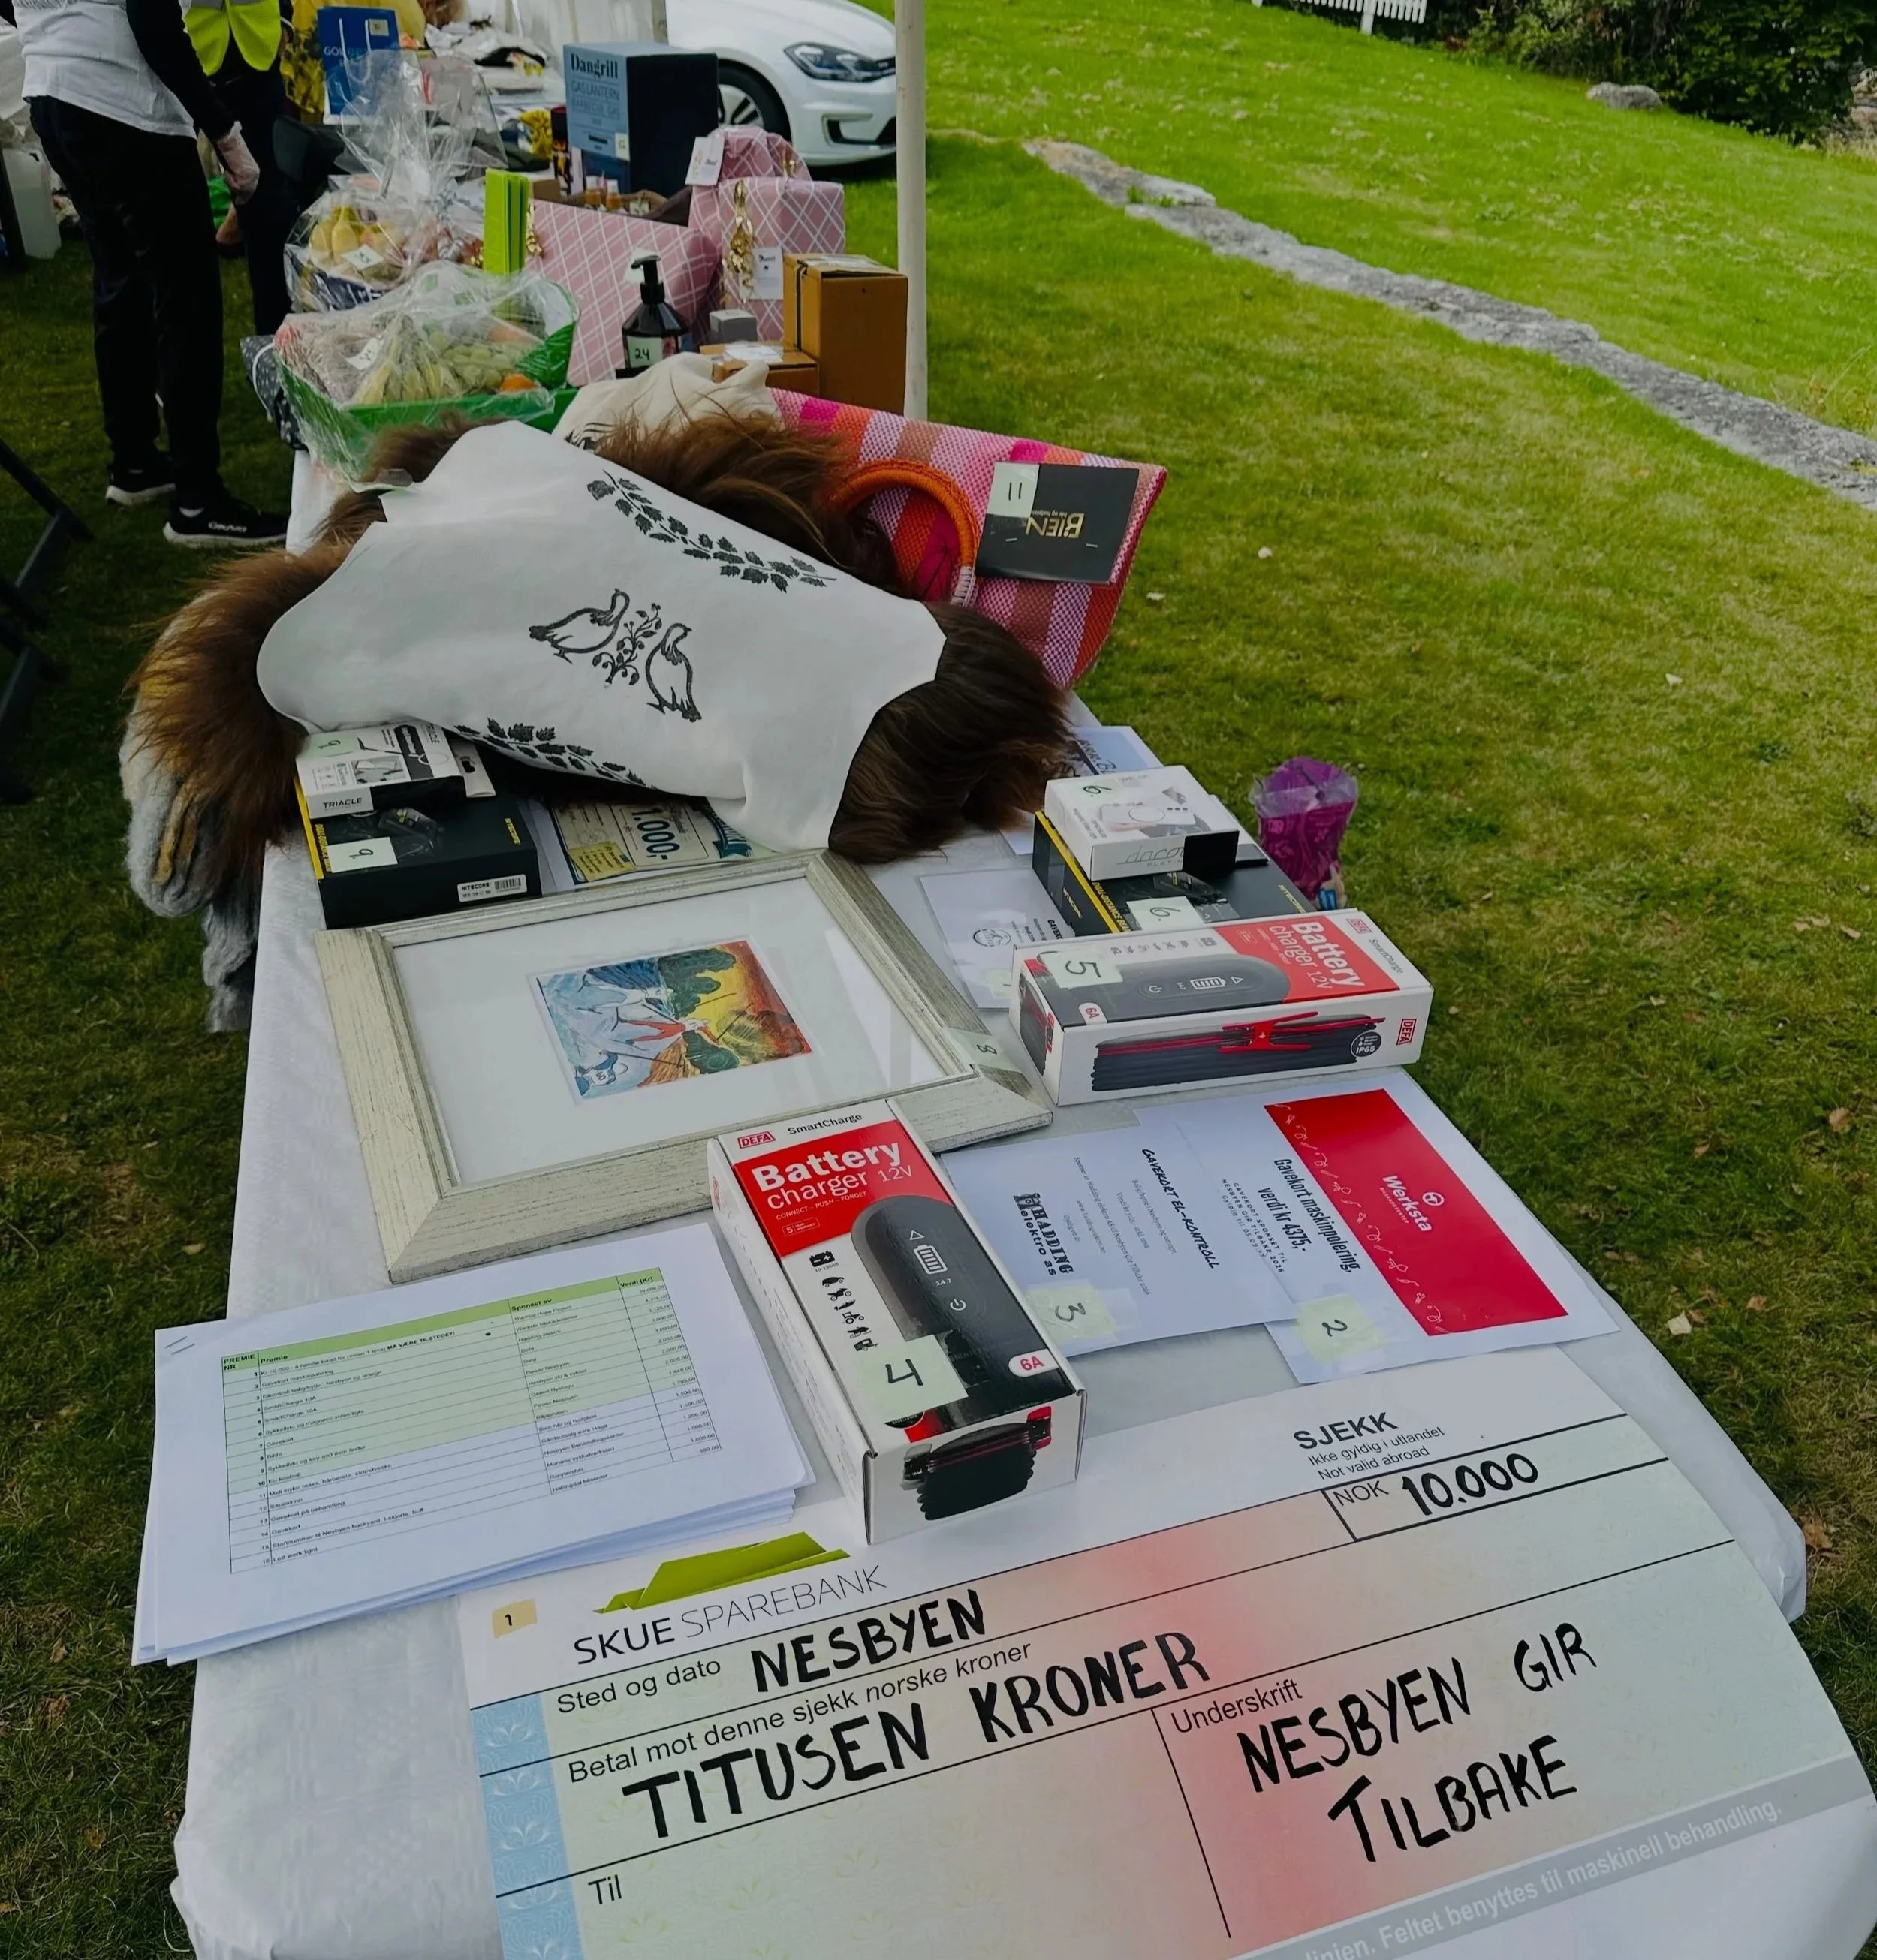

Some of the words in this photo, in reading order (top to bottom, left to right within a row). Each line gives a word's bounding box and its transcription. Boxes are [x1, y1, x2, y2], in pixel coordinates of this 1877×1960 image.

[571, 53, 619, 79] Dangrill
[634, 348, 649, 361] 24
[1008, 482, 1022, 501] 11
[1026, 513, 1084, 539] BIEN
[323, 797, 363, 809] TRIACLE
[461, 881, 490, 892] NITECORE
[1065, 960, 1101, 978] 5
[1269, 925, 1318, 968] charger
[1306, 971, 1333, 989] 12V
[1291, 921, 1366, 987] Battery
[1368, 938, 1405, 974] SmartCharge
[1085, 1007, 1099, 1019] 6A
[1399, 1021, 1414, 1043] DEFA
[740, 1132, 772, 1148] DEFA
[788, 1113, 863, 1135] SmartCharge
[751, 1142, 901, 1192] Battery
[767, 1171, 868, 1209] charger
[878, 1164, 913, 1183] 12V
[1258, 1188, 1286, 1211] verdi
[1382, 1175, 1433, 1232] Werksta
[776, 1205, 809, 1221] CONNECT
[815, 1199, 835, 1209] PUSH
[840, 1191, 867, 1202] FORGET
[1142, 1148, 1179, 1199] GAVEKORT
[1171, 1199, 1220, 1269] EL-KONTROLL
[1233, 1182, 1259, 1218] GAVEKORT
[1256, 1218, 1280, 1251] SPONSET
[1278, 1252, 1288, 1263] TIL
[1273, 1209, 1293, 1222] kr
[1274, 1158, 1313, 1198] Gavekort
[1300, 1196, 1361, 1274] maskinpolering,
[1020, 1209, 1047, 1256] elektro
[1044, 1260, 1056, 1276] as
[1031, 1206, 1074, 1274] HADDING
[1222, 1179, 1243, 1209] NESBYEN
[1242, 1211, 1252, 1224] GIR
[1251, 1224, 1273, 1254] TILBAKE
[1270, 1254, 1285, 1273] 2026
[1282, 1222, 1312, 1252] 4375,-
[1055, 1302, 1086, 1323] 3
[1321, 1318, 1348, 1337] 2
[224, 1354, 255, 1364] PREMIE
[260, 1355, 288, 1364] Premie
[885, 1359, 923, 1386] 4
[1020, 1356, 1044, 1371] 6A
[1293, 1411, 1399, 1450] SJEKK
[1308, 1452, 1338, 1466] Ikke
[1340, 1441, 1381, 1462] gyldig
[1391, 1426, 1445, 1447] utlandet
[1318, 1467, 1345, 1480] Not
[1347, 1458, 1380, 1474] valid
[1382, 1446, 1430, 1466] abroad
[1333, 1480, 1389, 1507] NOK
[1401, 1453, 1538, 1516] 10.000
[504, 1613, 513, 1627] 1
[573, 1617, 676, 1665] SKUE
[680, 1564, 888, 1639] SPAREBANK
[751, 1588, 986, 1694] NESBYEN
[557, 1685, 617, 1714] Sted
[625, 1675, 658, 1698] og
[666, 1658, 721, 1686] dato
[568, 1745, 638, 1783] Betal
[646, 1733, 697, 1763] mot
[703, 1710, 785, 1745] denne
[792, 1689, 857, 1725] sjekk
[866, 1663, 948, 1703] norske
[955, 1641, 1032, 1678] kroner
[1171, 1677, 1303, 1735] Underskrift
[1237, 1657, 1472, 1794] NESBYEN
[1514, 1621, 1598, 1694] GIR
[622, 1702, 929, 1839] TITUSEN
[968, 1630, 1210, 1744] KRONER
[1327, 1733, 1579, 1863] TILBAKE
[588, 1874, 623, 1905] Til
[1378, 1910, 1443, 1949] Feltet
[1445, 1884, 1539, 1927] benyttes
[1540, 1870, 1564, 1893] til
[1566, 1838, 1665, 1885] maskinell
[1664, 1802, 1783, 1850] behandling.
